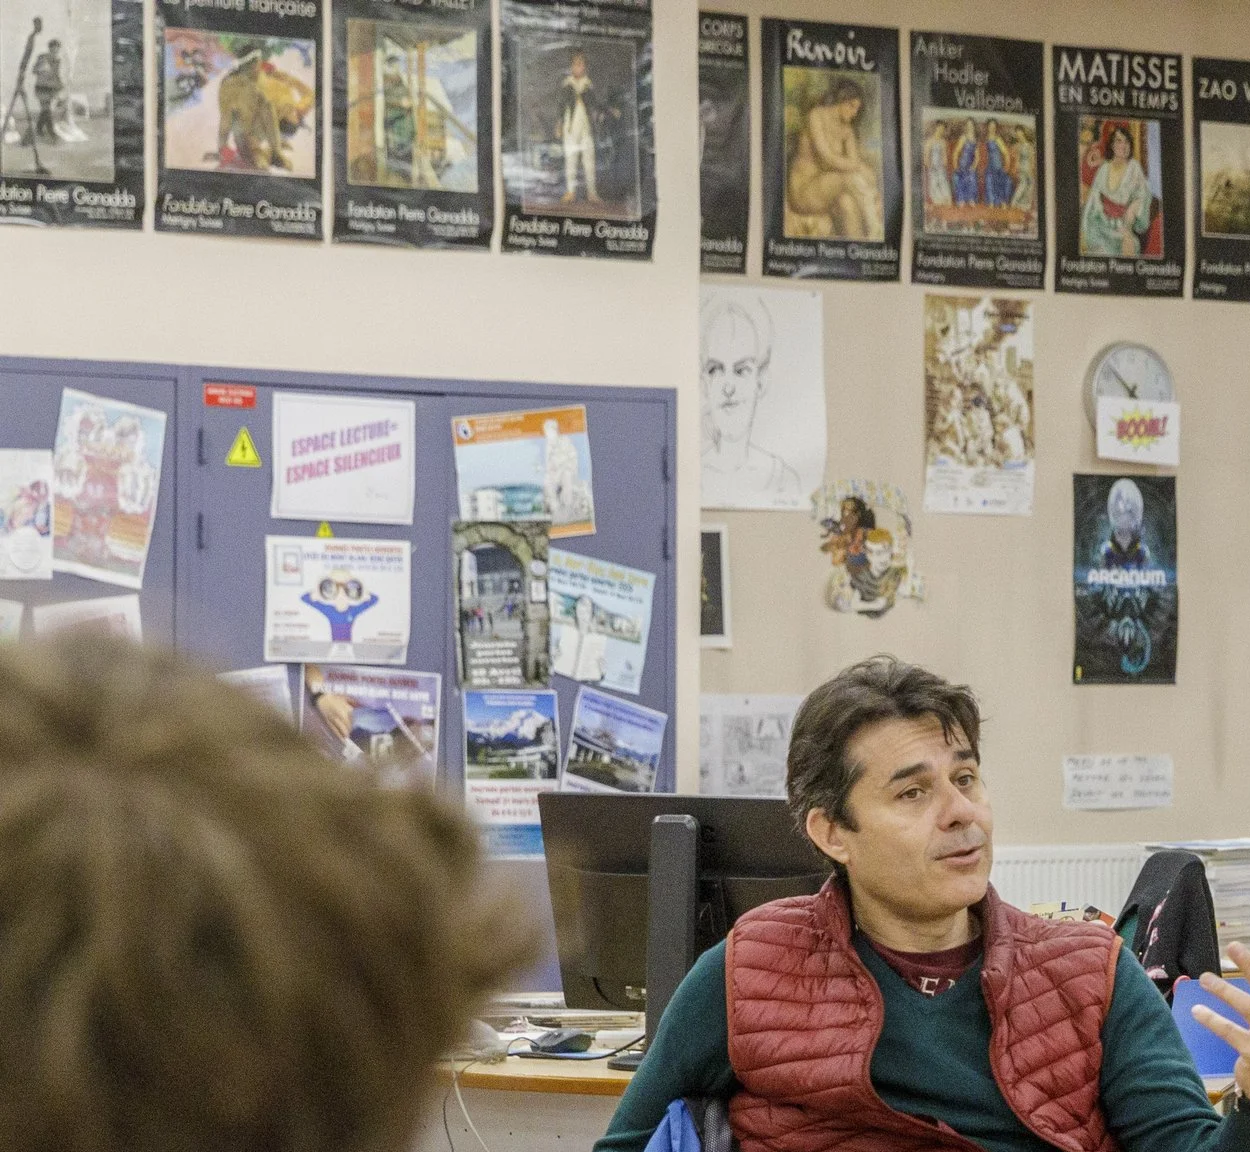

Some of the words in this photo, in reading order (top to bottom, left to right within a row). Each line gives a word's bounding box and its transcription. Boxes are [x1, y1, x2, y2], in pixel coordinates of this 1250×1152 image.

[786, 29, 874, 70] Renoir
[915, 38, 964, 59] Anker
[933, 62, 990, 86] Hodler
[1058, 52, 1178, 90] MATISSE
[1060, 84, 1083, 104] EN
[1089, 87, 1125, 107] SON
[1132, 92, 1178, 112] TEMPS
[1200, 78, 1237, 101] ZAO
[37, 183, 69, 203] Pierre
[73, 186, 136, 207] Gianadda
[162, 193, 220, 214] Fondation
[221, 198, 253, 218] Pierre
[256, 200, 317, 222] Gianadda
[348, 200, 396, 221] Fondation
[399, 206, 425, 222] Pierre
[427, 206, 480, 225] Gianadda
[509, 215, 559, 236] Fondation
[563, 220, 591, 238] Pierre
[595, 221, 649, 242] Gianadda
[768, 239, 816, 258] Fondation
[848, 242, 898, 262] Gianadda
[917, 251, 966, 269] Fondation
[968, 255, 995, 271] Pierre
[996, 256, 1043, 275] Gianadda
[1061, 256, 1107, 274] Fondation
[1109, 259, 1134, 275] Pierre
[1136, 259, 1182, 278] Gianadda
[1200, 260, 1243, 276] Fondation
[1116, 415, 1168, 441] BOOM!
[292, 432, 336, 458] ESPACE
[286, 463, 330, 485] ESPACE
[334, 443, 401, 475] SILENCIEUX
